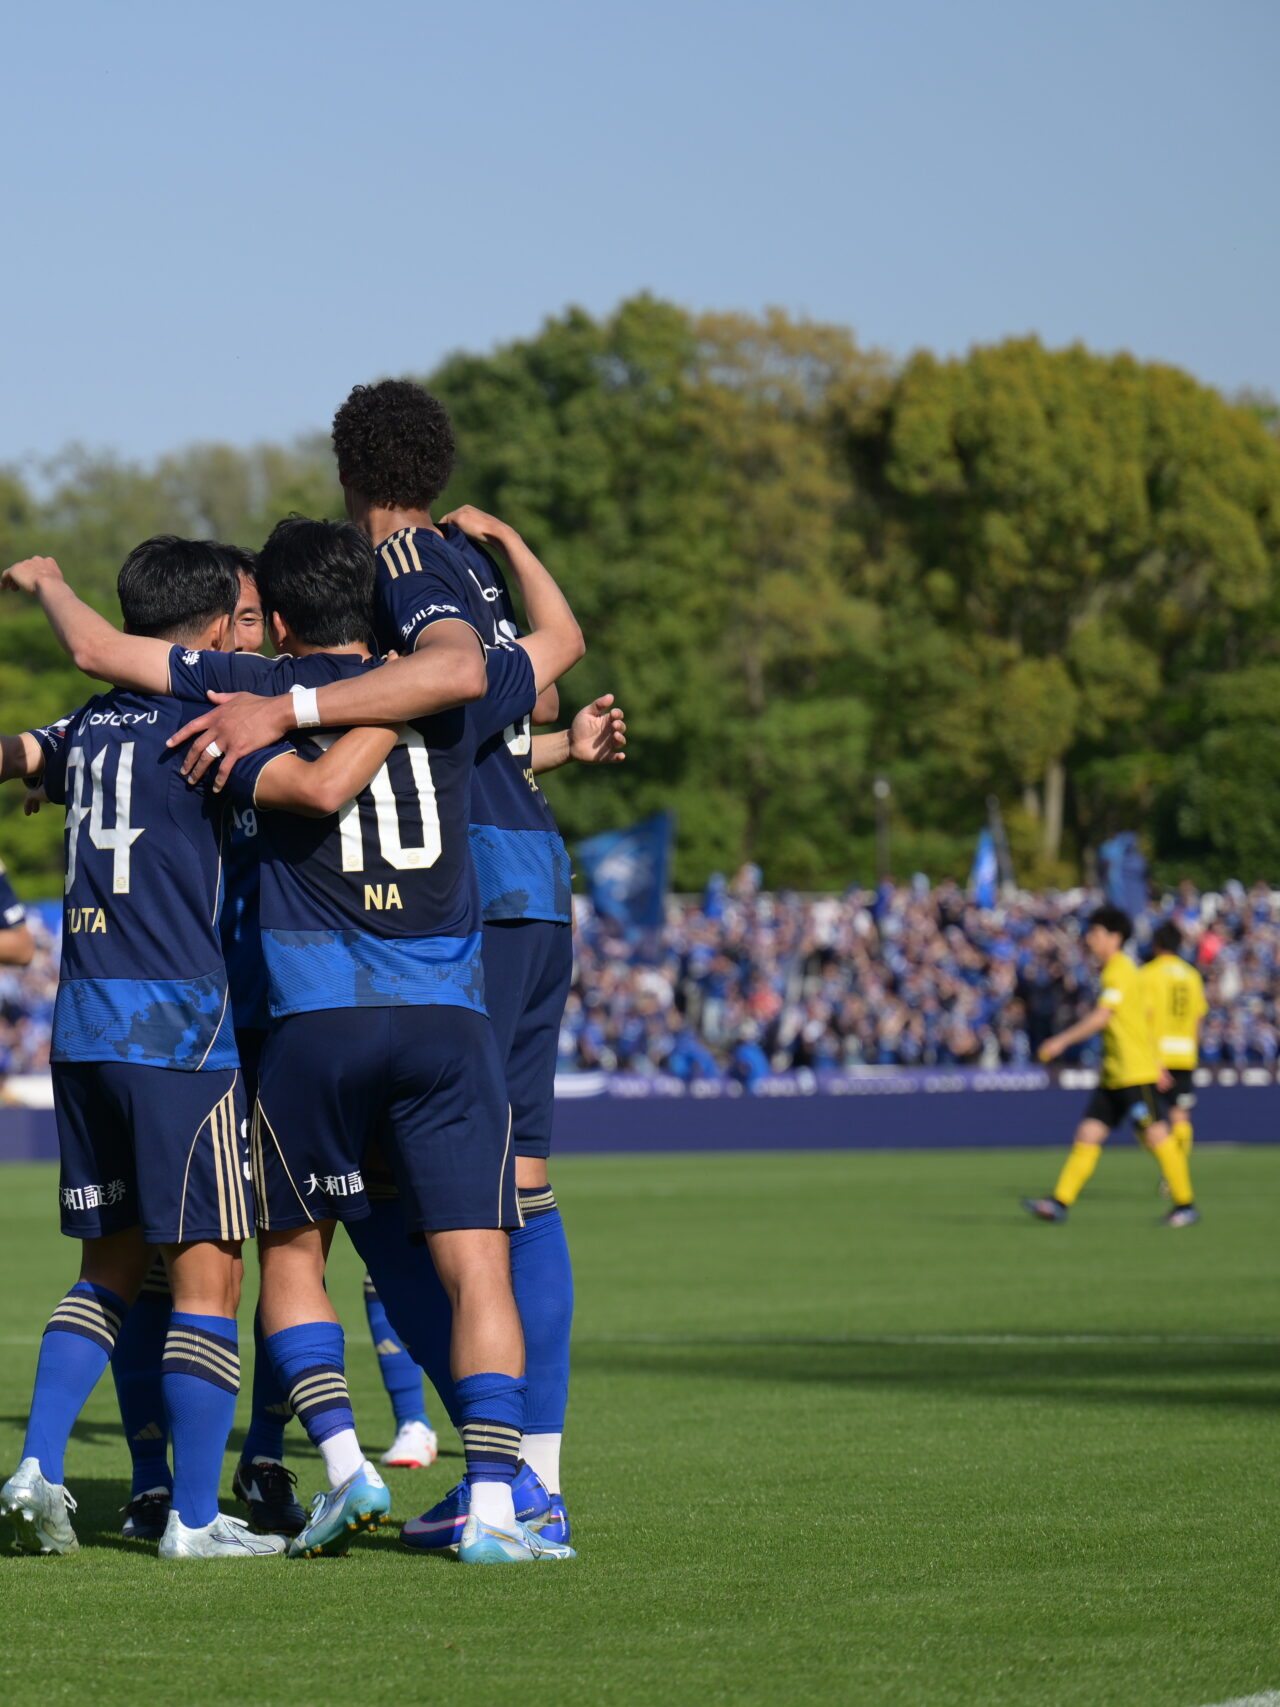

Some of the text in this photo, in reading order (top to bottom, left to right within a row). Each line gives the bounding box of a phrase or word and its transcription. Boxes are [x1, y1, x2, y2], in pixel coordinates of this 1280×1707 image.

[364, 884, 404, 910] NA
[67, 908, 107, 934] UTA
[61, 1180, 126, 1210] 和証券
